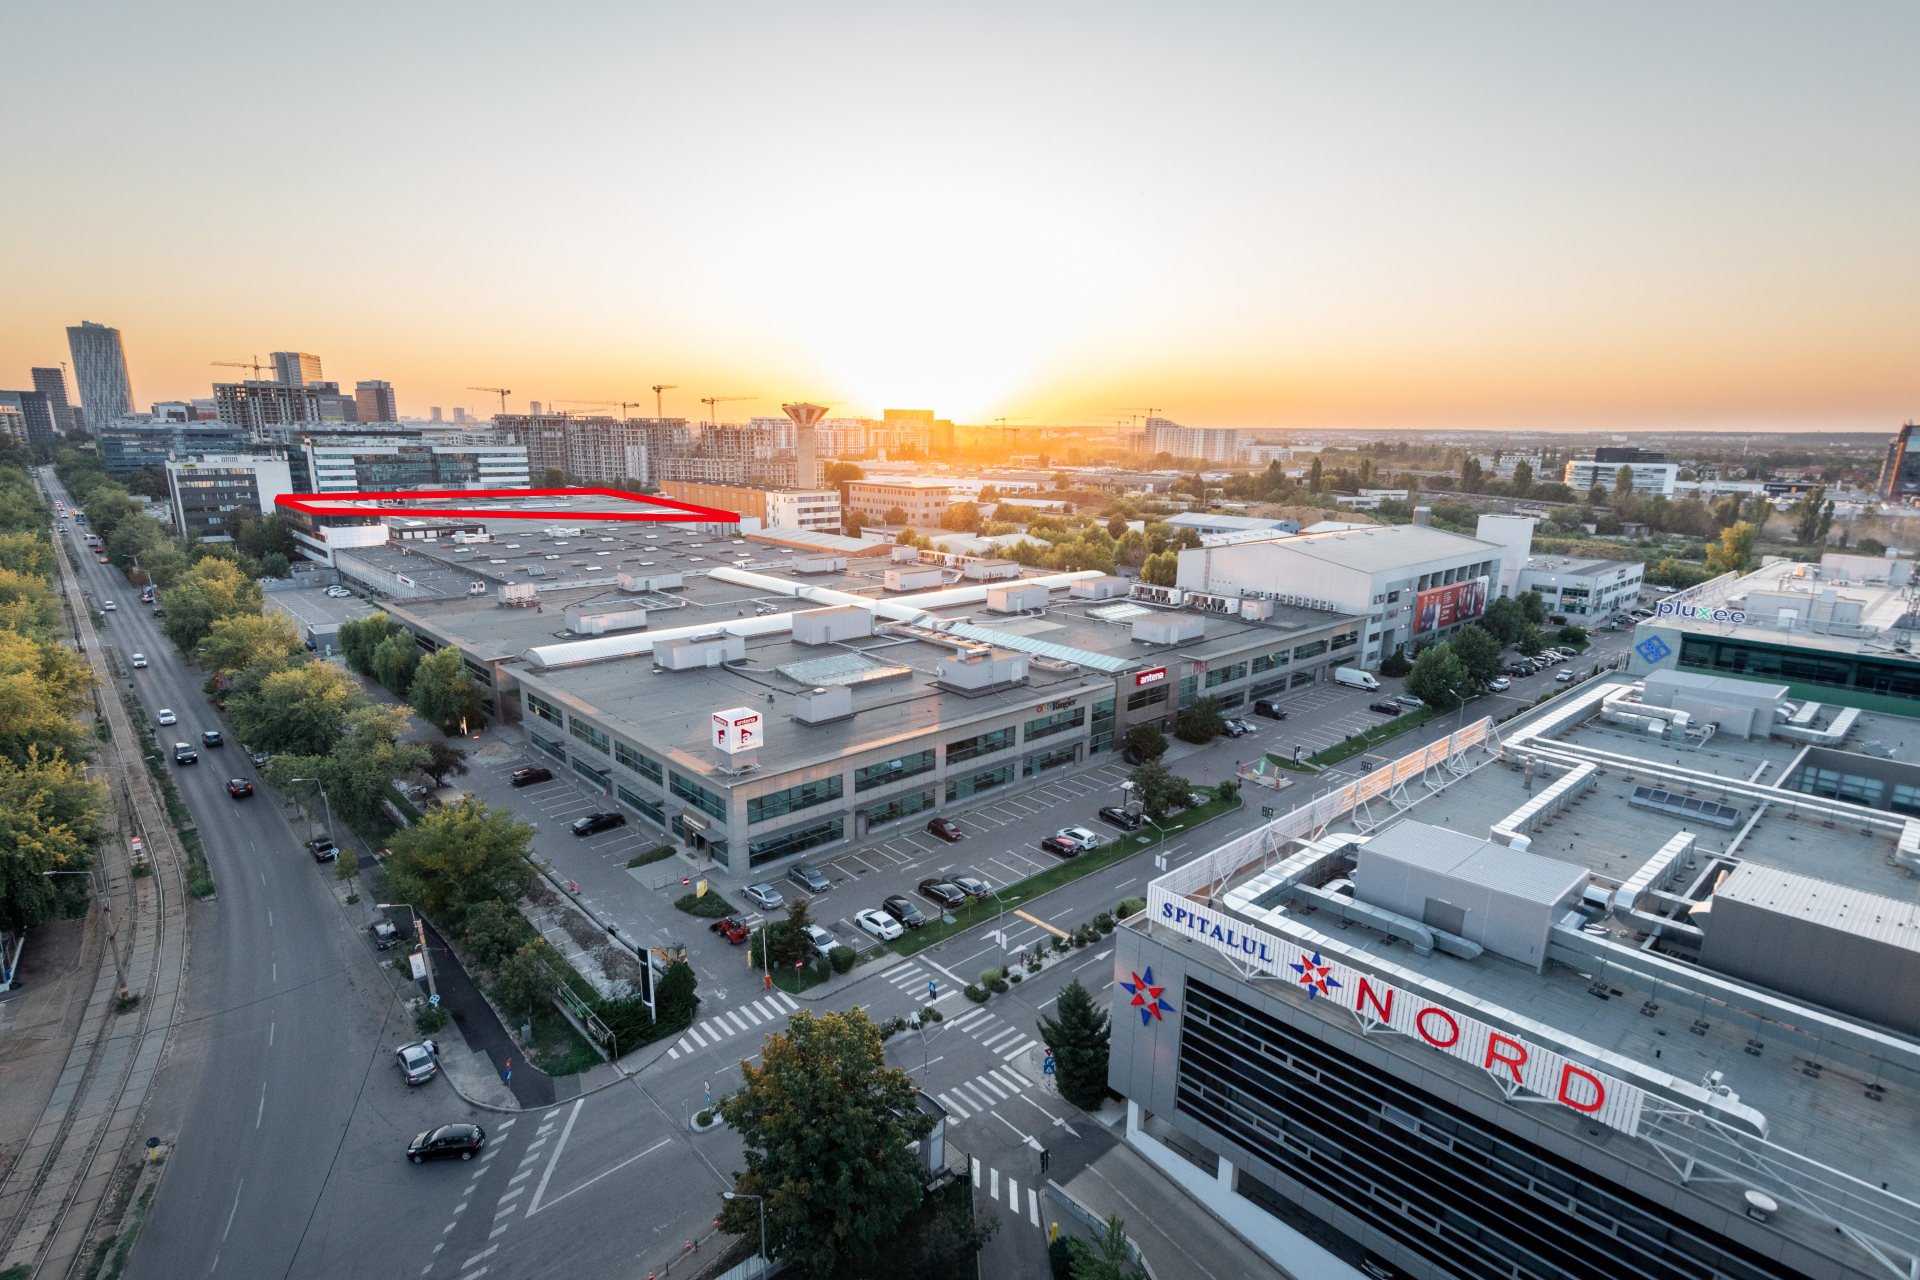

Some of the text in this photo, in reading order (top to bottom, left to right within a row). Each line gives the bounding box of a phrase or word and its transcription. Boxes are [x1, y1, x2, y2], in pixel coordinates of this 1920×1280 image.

[1657, 601, 1746, 623] pluxee
[1140, 671, 1164, 684] antena
[1052, 697, 1077, 711] Ringier
[736, 717, 756, 726] antena
[1163, 902, 1605, 1113] SPITALUL NORD
